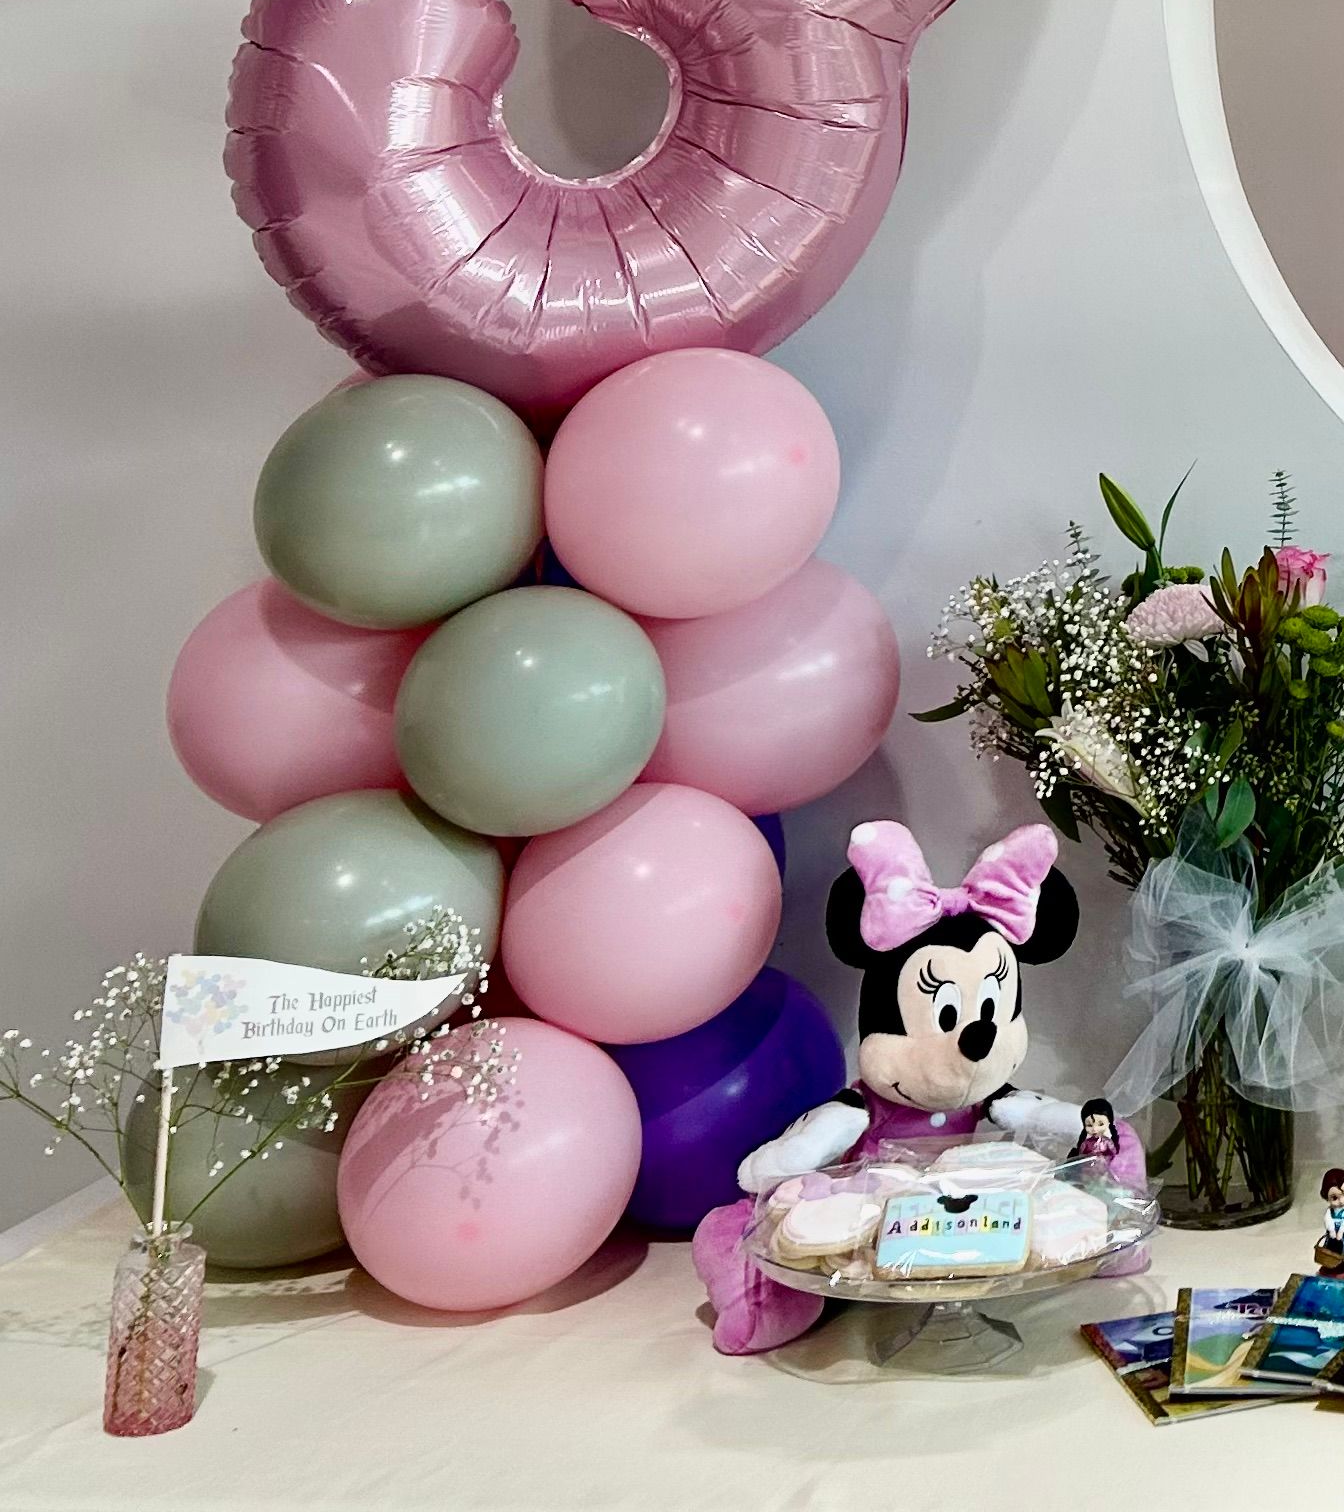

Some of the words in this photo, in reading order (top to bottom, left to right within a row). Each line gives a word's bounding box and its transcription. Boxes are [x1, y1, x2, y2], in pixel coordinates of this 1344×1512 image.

[267, 992, 300, 1015] The
[308, 985, 378, 1011] Happiest
[241, 1017, 315, 1040] Birthday
[321, 1014, 347, 1034] On
[353, 1008, 398, 1031] Earth
[887, 1215, 1022, 1235] Addisonland
